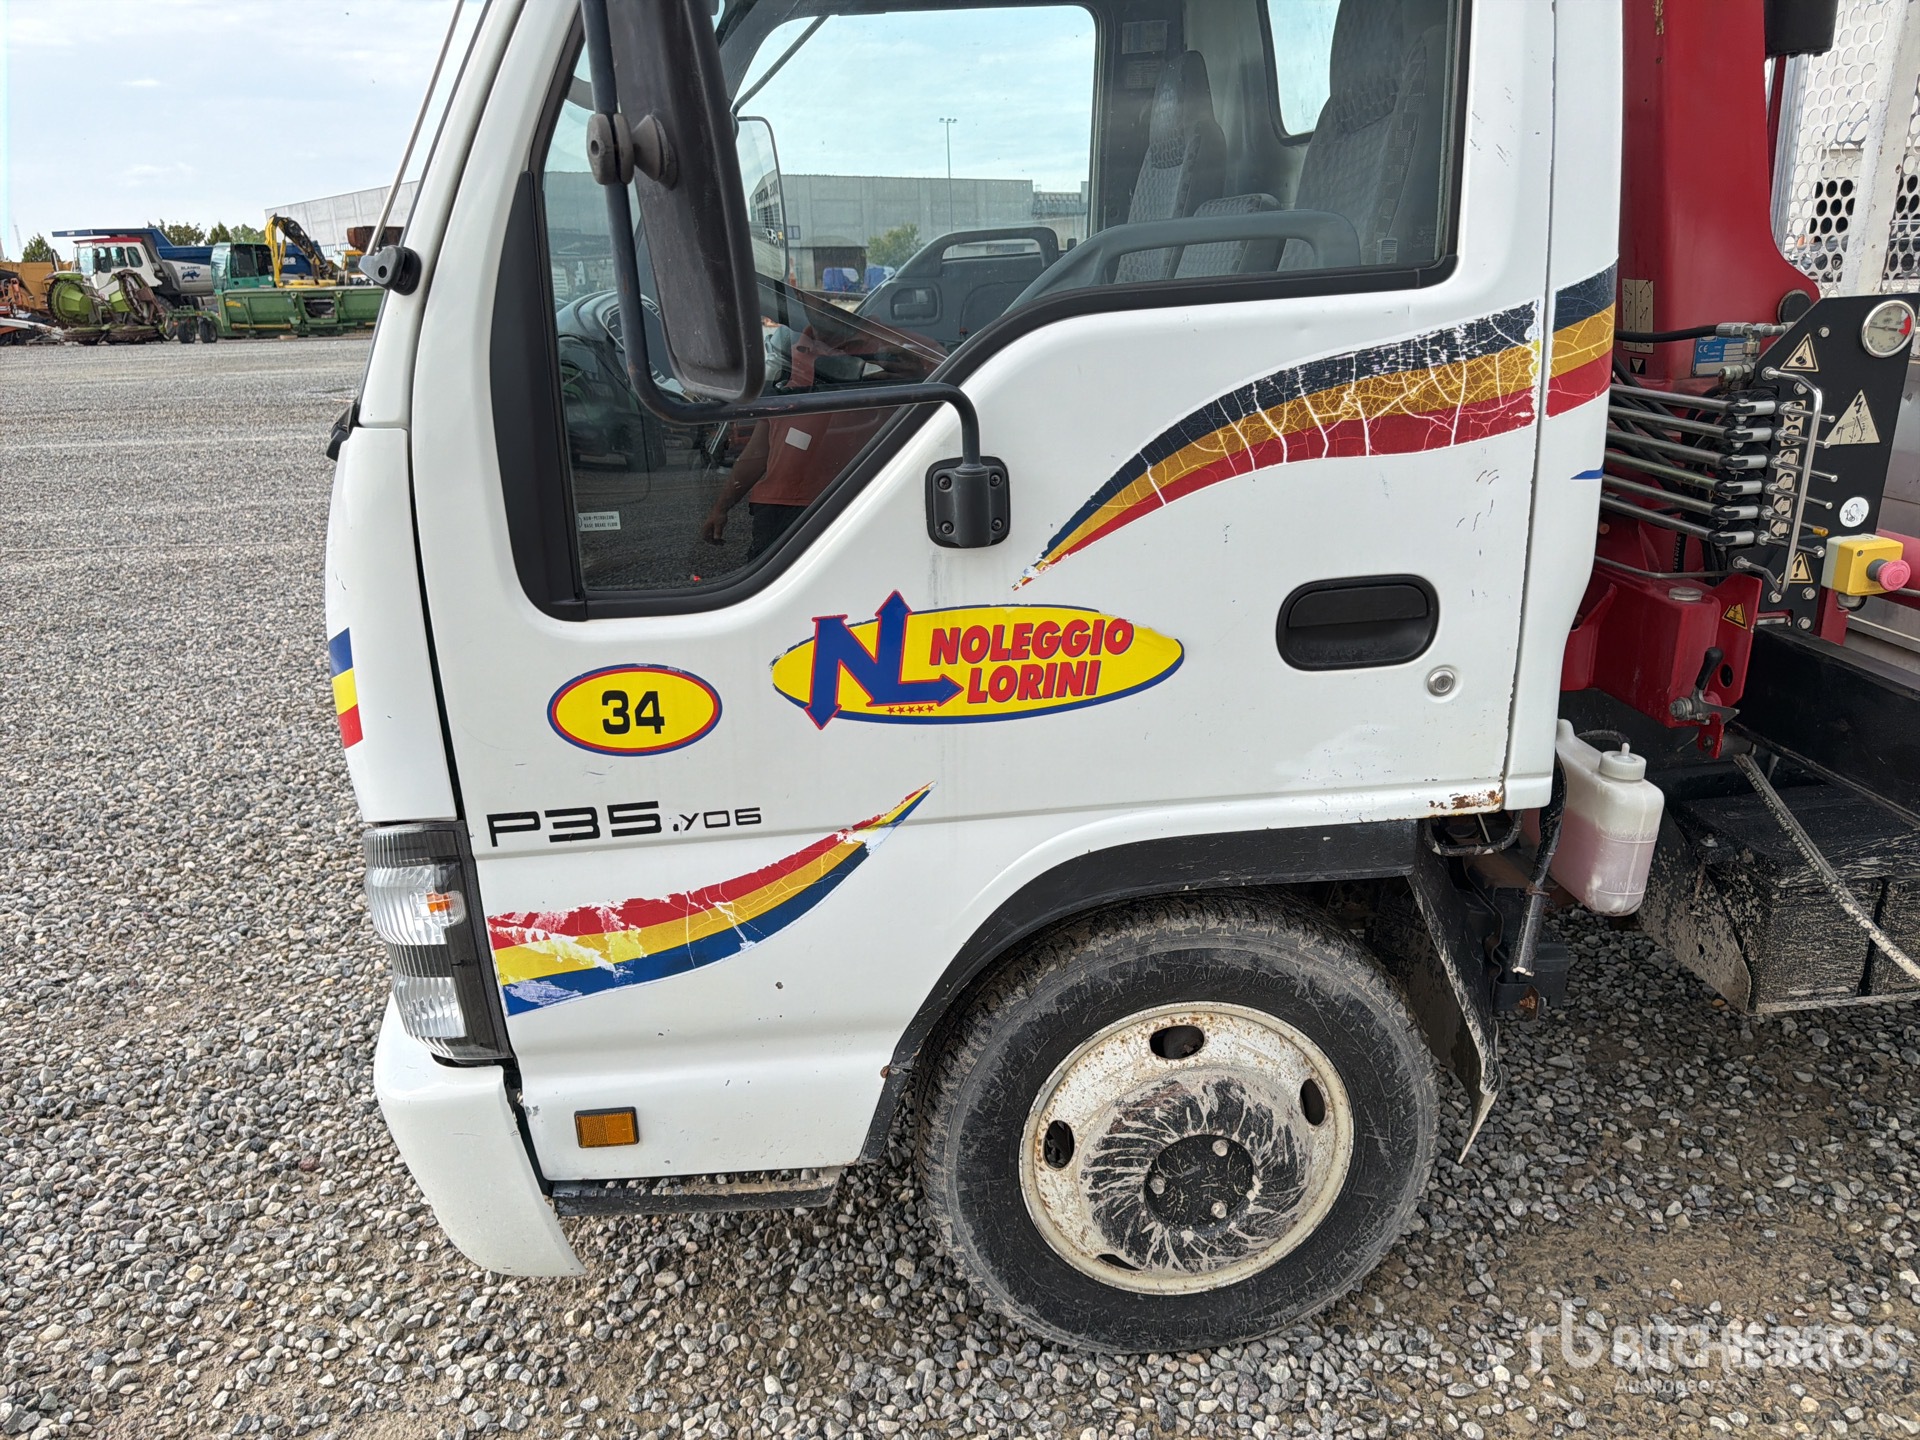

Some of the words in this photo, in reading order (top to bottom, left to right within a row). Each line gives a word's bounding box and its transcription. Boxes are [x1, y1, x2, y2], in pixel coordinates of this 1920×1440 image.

[929, 618, 1134, 666] NOLEGGIO
[967, 660, 1101, 704] LORINI
[602, 689, 666, 735] 34
